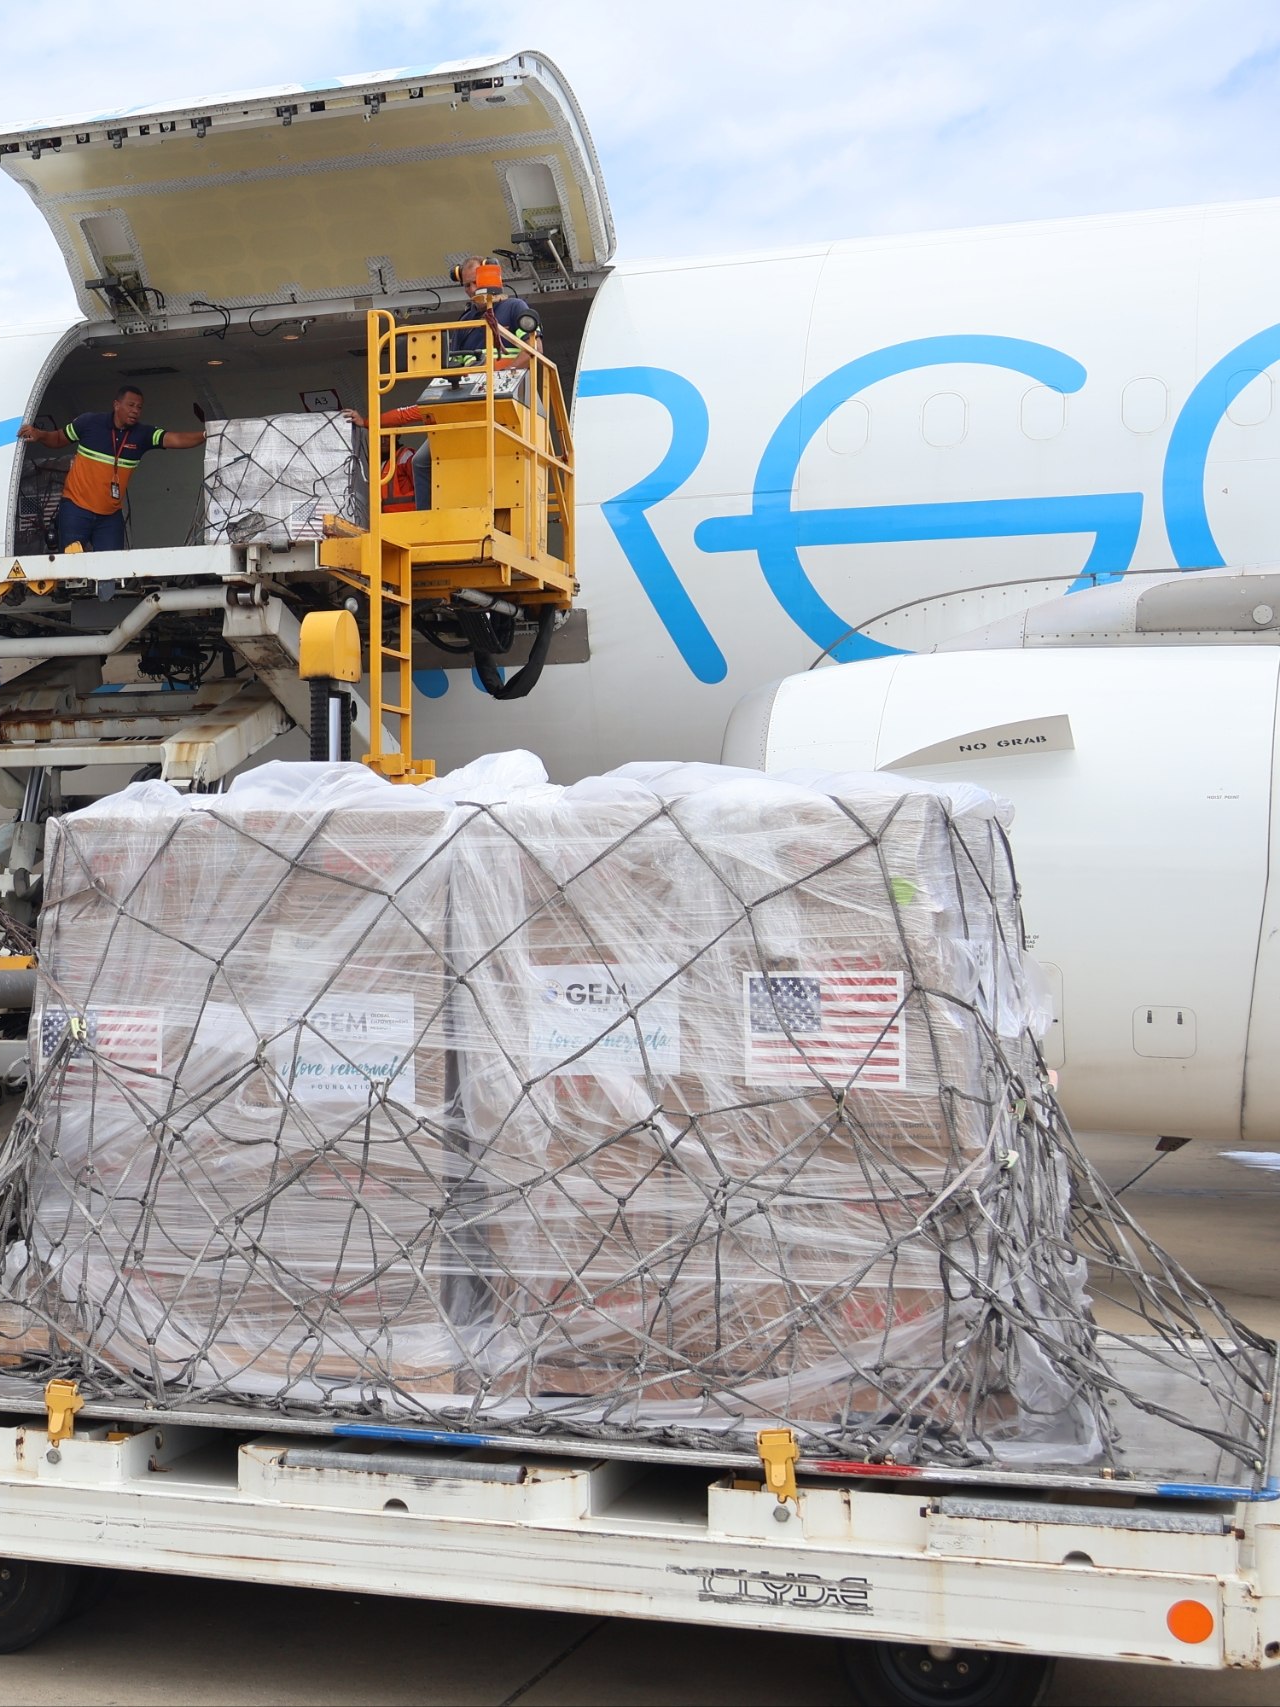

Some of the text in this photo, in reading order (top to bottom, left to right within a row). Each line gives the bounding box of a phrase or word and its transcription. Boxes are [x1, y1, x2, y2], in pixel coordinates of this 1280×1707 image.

[314, 396, 329, 405] A3
[959, 735, 1047, 752] NO GRAB
[565, 983, 628, 1005] GEM
[311, 1012, 368, 1033] GEM
